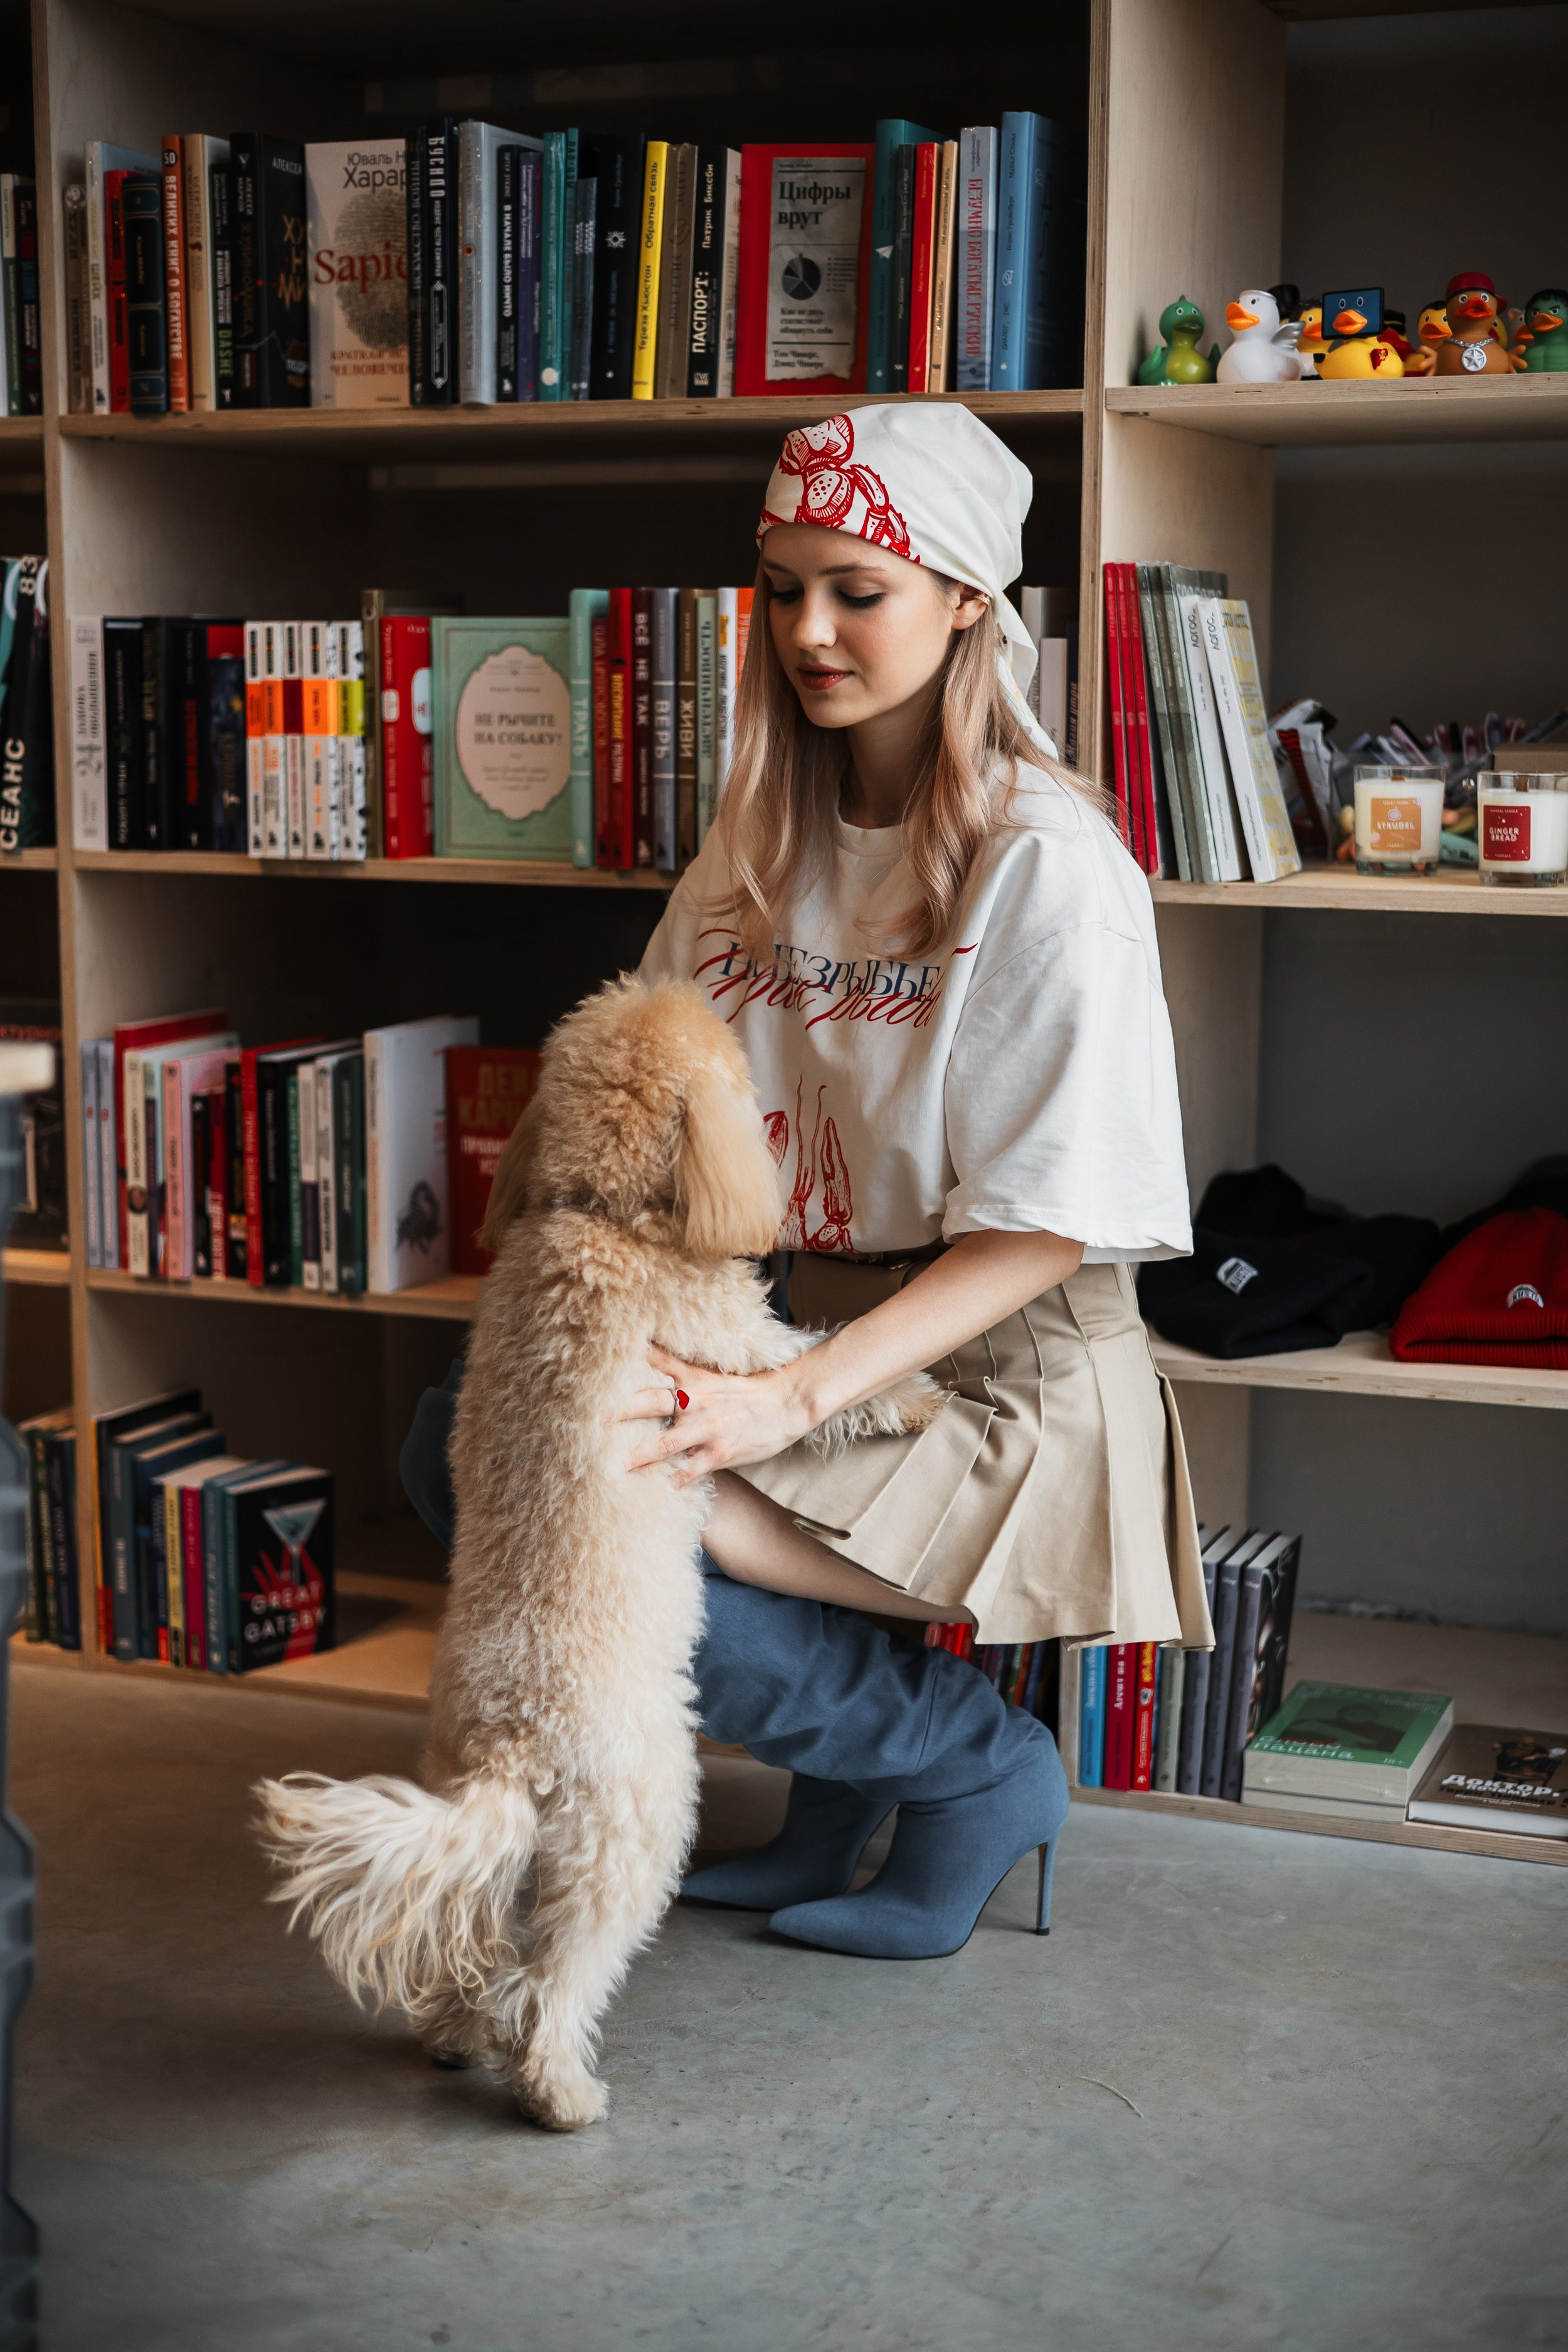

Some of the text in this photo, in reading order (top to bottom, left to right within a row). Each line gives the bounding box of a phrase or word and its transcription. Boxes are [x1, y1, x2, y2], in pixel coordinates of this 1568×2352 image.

[347, 152, 389, 165] Юваль
[428, 136, 446, 198] БУСИДО
[778, 181, 851, 204] Цифры
[777, 210, 823, 230] врут
[1007, 196, 1015, 229] Гройсберг
[503, 213, 512, 251] НАЧАЛЕ
[163, 149, 183, 360] 50 ВЕЛИКИХ КНИГ О БОГАТСТВЕ
[412, 213, 423, 290] ИСКУССТВО
[503, 253, 512, 283] БЫЛО
[637, 162, 658, 351] Тереза Хьюстон Обратная связь
[691, 164, 714, 354] ПАСПОРТ: Патрик Биксби
[965, 178, 983, 358] БЕЗУМНО БОГАТЫЕ РУССКИЕ
[503, 285, 512, 317] НИЧТО
[217, 329, 234, 377] DASHE
[19, 556, 38, 596] 83
[635, 612, 651, 726] ВСЁ НЕ ТАК
[1068, 682, 1078, 715] утра
[473, 731, 496, 745] НА
[497, 712, 556, 727] РЫЧИТЕ
[572, 697, 590, 757] ТРАТЬ
[654, 699, 671, 759] ВЕРЬ
[679, 699, 695, 758] ЖИВИ
[0, 738, 26, 850] СЕАНС
[1376, 821, 1415, 830] STRUDEL
[1489, 827, 1520, 835] GINGER
[1491, 834, 1517, 842] BREAD
[251, 1581, 321, 1616] GREAT
[244, 1606, 327, 1645] GATSBY
[1253, 1742, 1354, 1760] пацана
